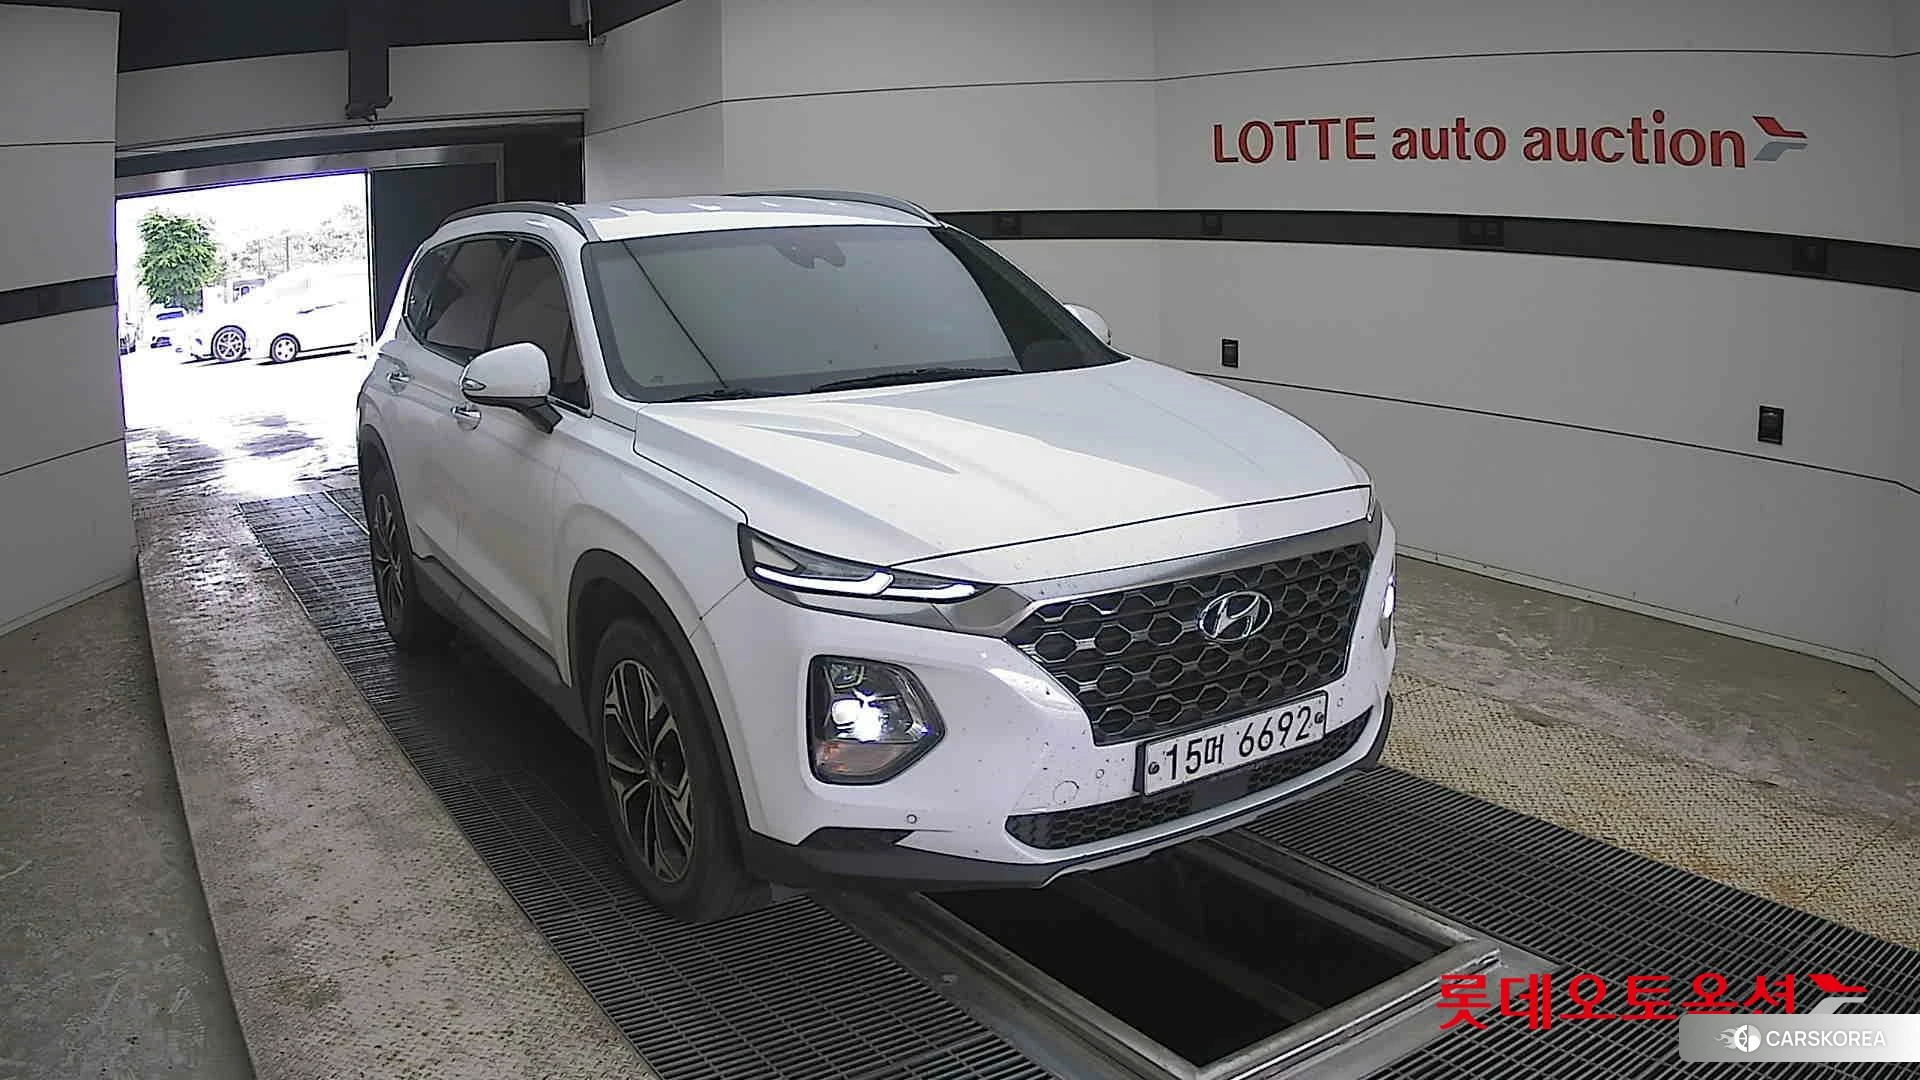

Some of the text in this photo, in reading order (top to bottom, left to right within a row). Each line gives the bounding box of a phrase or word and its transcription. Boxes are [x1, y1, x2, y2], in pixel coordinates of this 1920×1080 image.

[1213, 110, 1746, 168] LOTTE auto auction
[1165, 706, 1311, 780] 15머 6692
